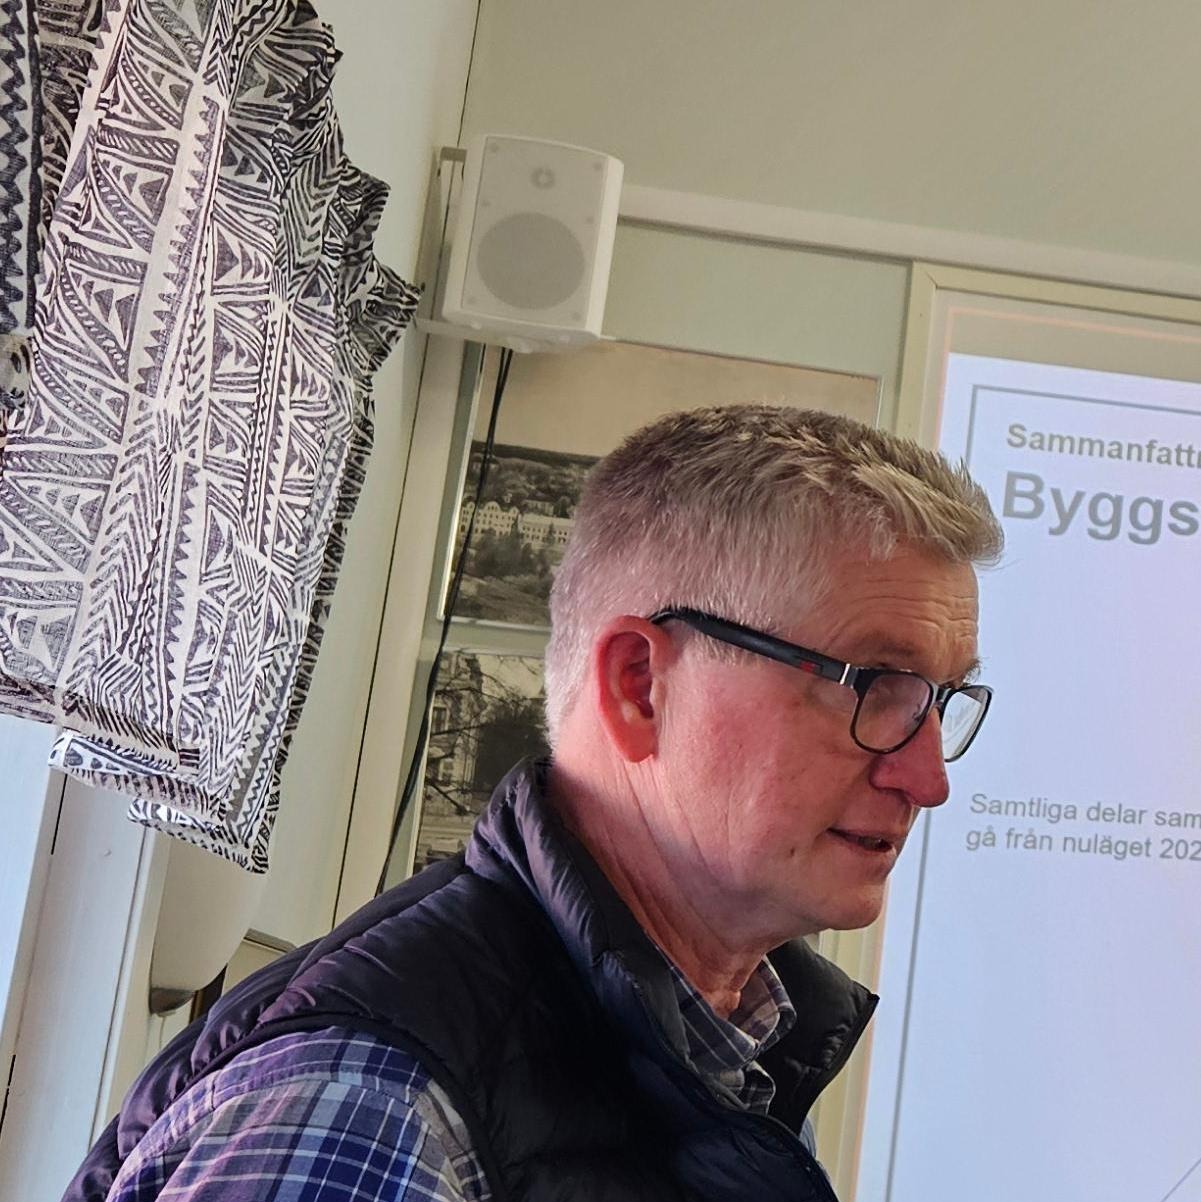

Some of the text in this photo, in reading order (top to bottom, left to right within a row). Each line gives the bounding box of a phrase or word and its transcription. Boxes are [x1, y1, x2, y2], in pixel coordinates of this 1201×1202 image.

[970, 793, 1078, 824] Samtliga
[1086, 802, 1147, 825] delar
[966, 825, 996, 851] gå
[1005, 828, 1053, 851] från
[1062, 833, 1152, 861] nuläget
